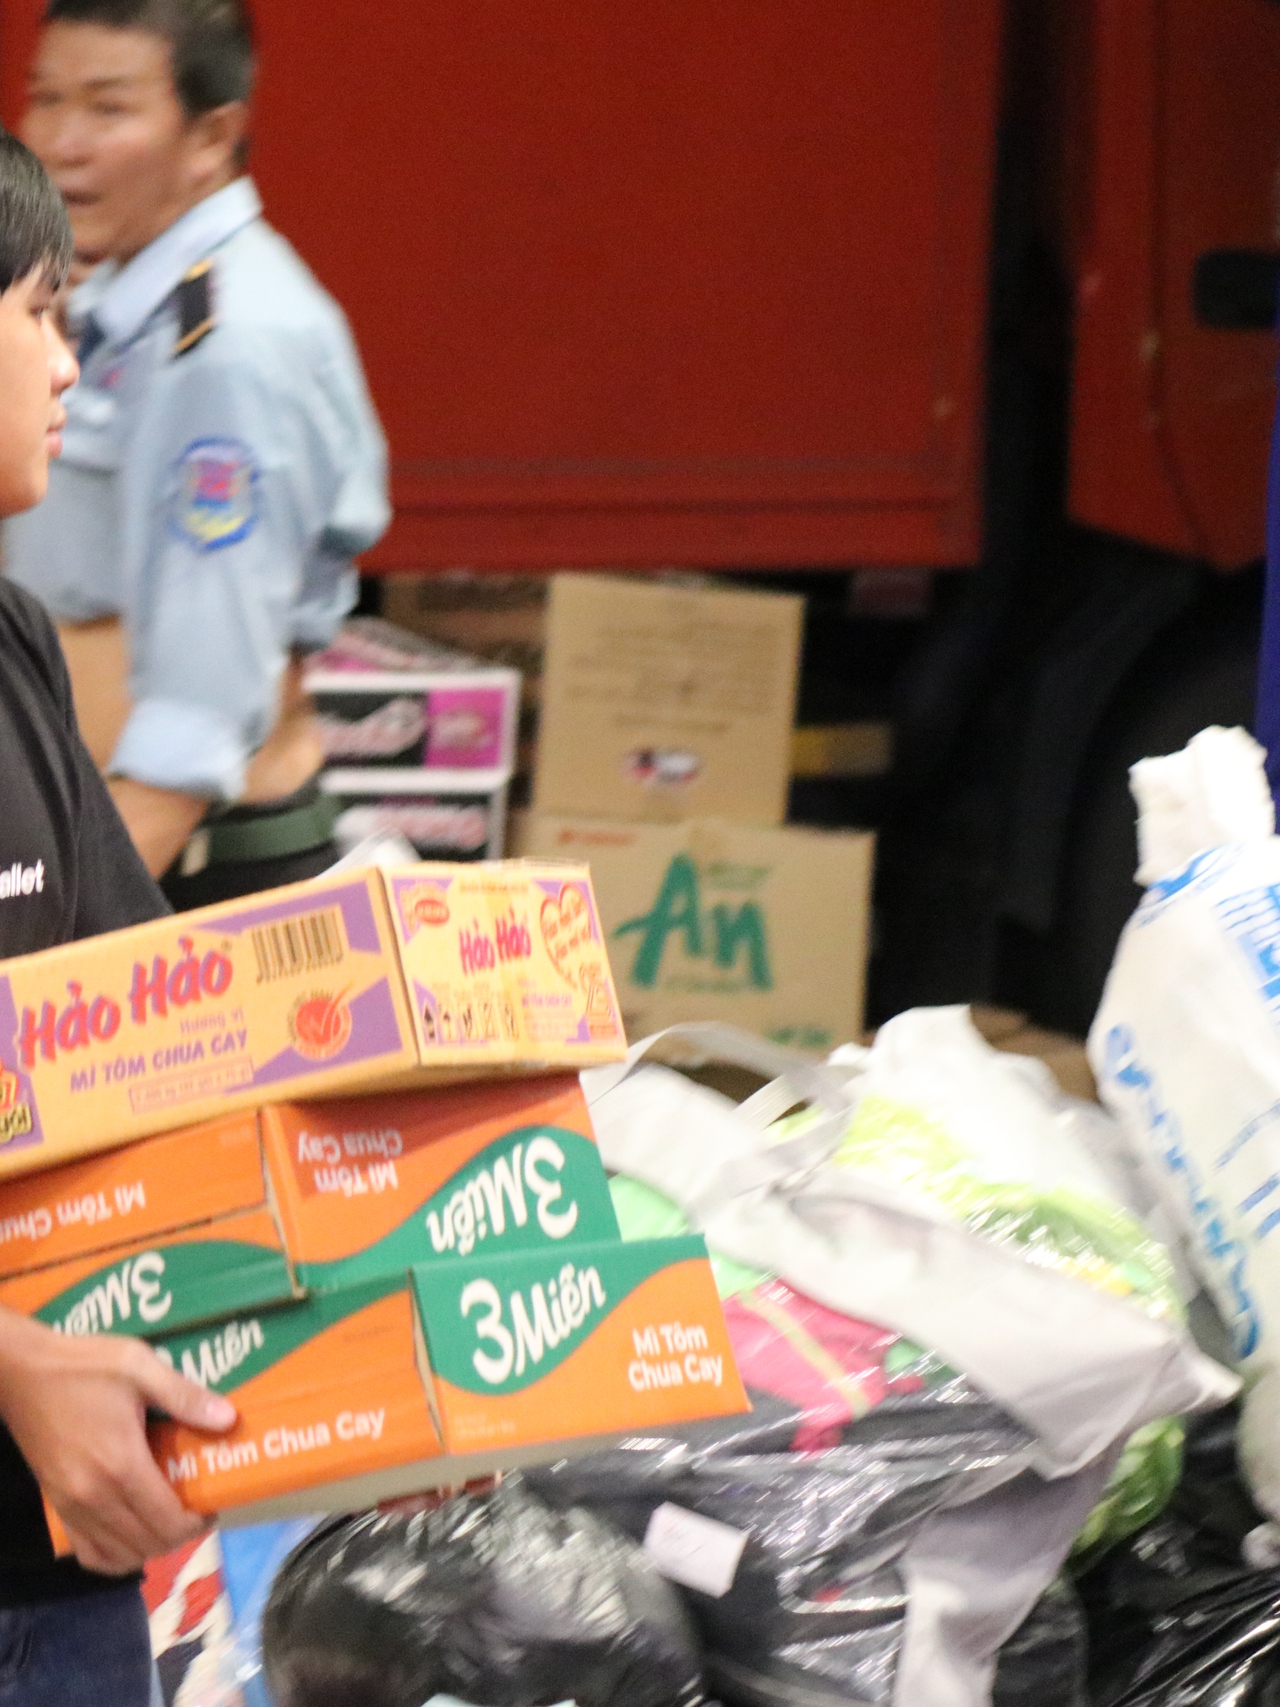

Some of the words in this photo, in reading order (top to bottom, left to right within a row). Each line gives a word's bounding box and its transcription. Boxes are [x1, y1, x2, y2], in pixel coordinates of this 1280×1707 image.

[19, 979, 122, 1073] Hảo
[128, 935, 234, 1026] Hảo
[104, 1055, 147, 1085] TÔM
[153, 1041, 206, 1069] CHUA
[210, 1029, 248, 1055] CAY
[660, 1322, 709, 1354] Tôm
[628, 1358, 683, 1391] Chua
[684, 1354, 723, 1387] Cay
[201, 1440, 259, 1474] Tôm
[263, 1421, 331, 1460] Chua
[336, 1407, 386, 1440] Cay
